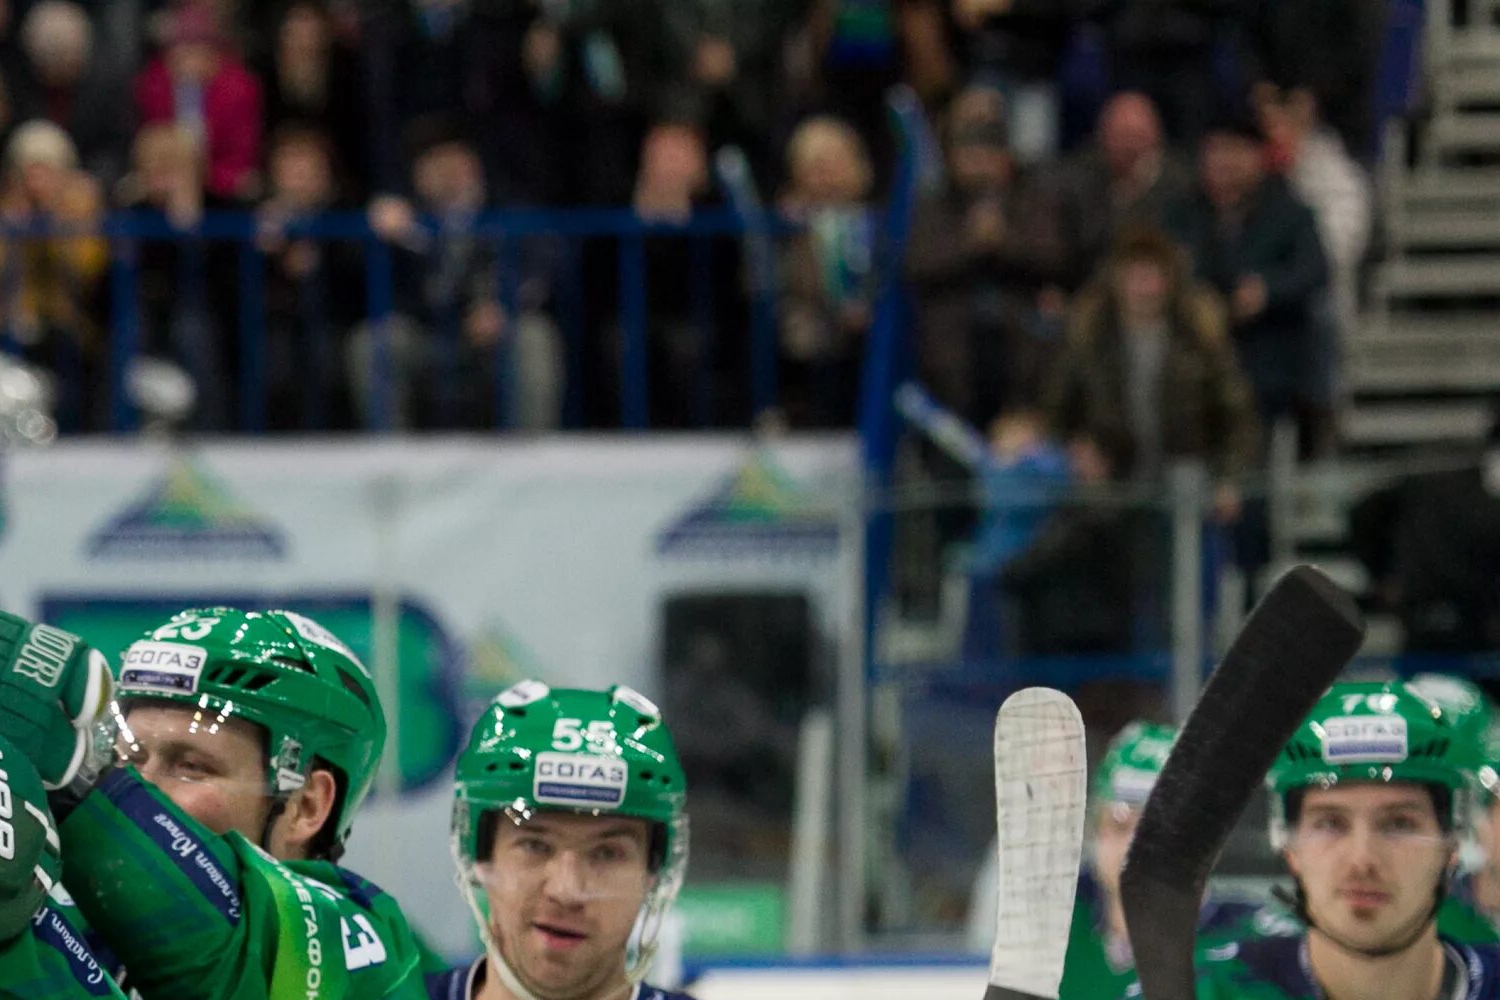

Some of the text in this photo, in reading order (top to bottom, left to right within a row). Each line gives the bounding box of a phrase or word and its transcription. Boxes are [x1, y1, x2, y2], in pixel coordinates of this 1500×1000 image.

[153, 616, 221, 641] 23
[127, 649, 201, 671] СОГАЗ
[551, 717, 618, 754] 55
[538, 761, 624, 782] СОГАЗ
